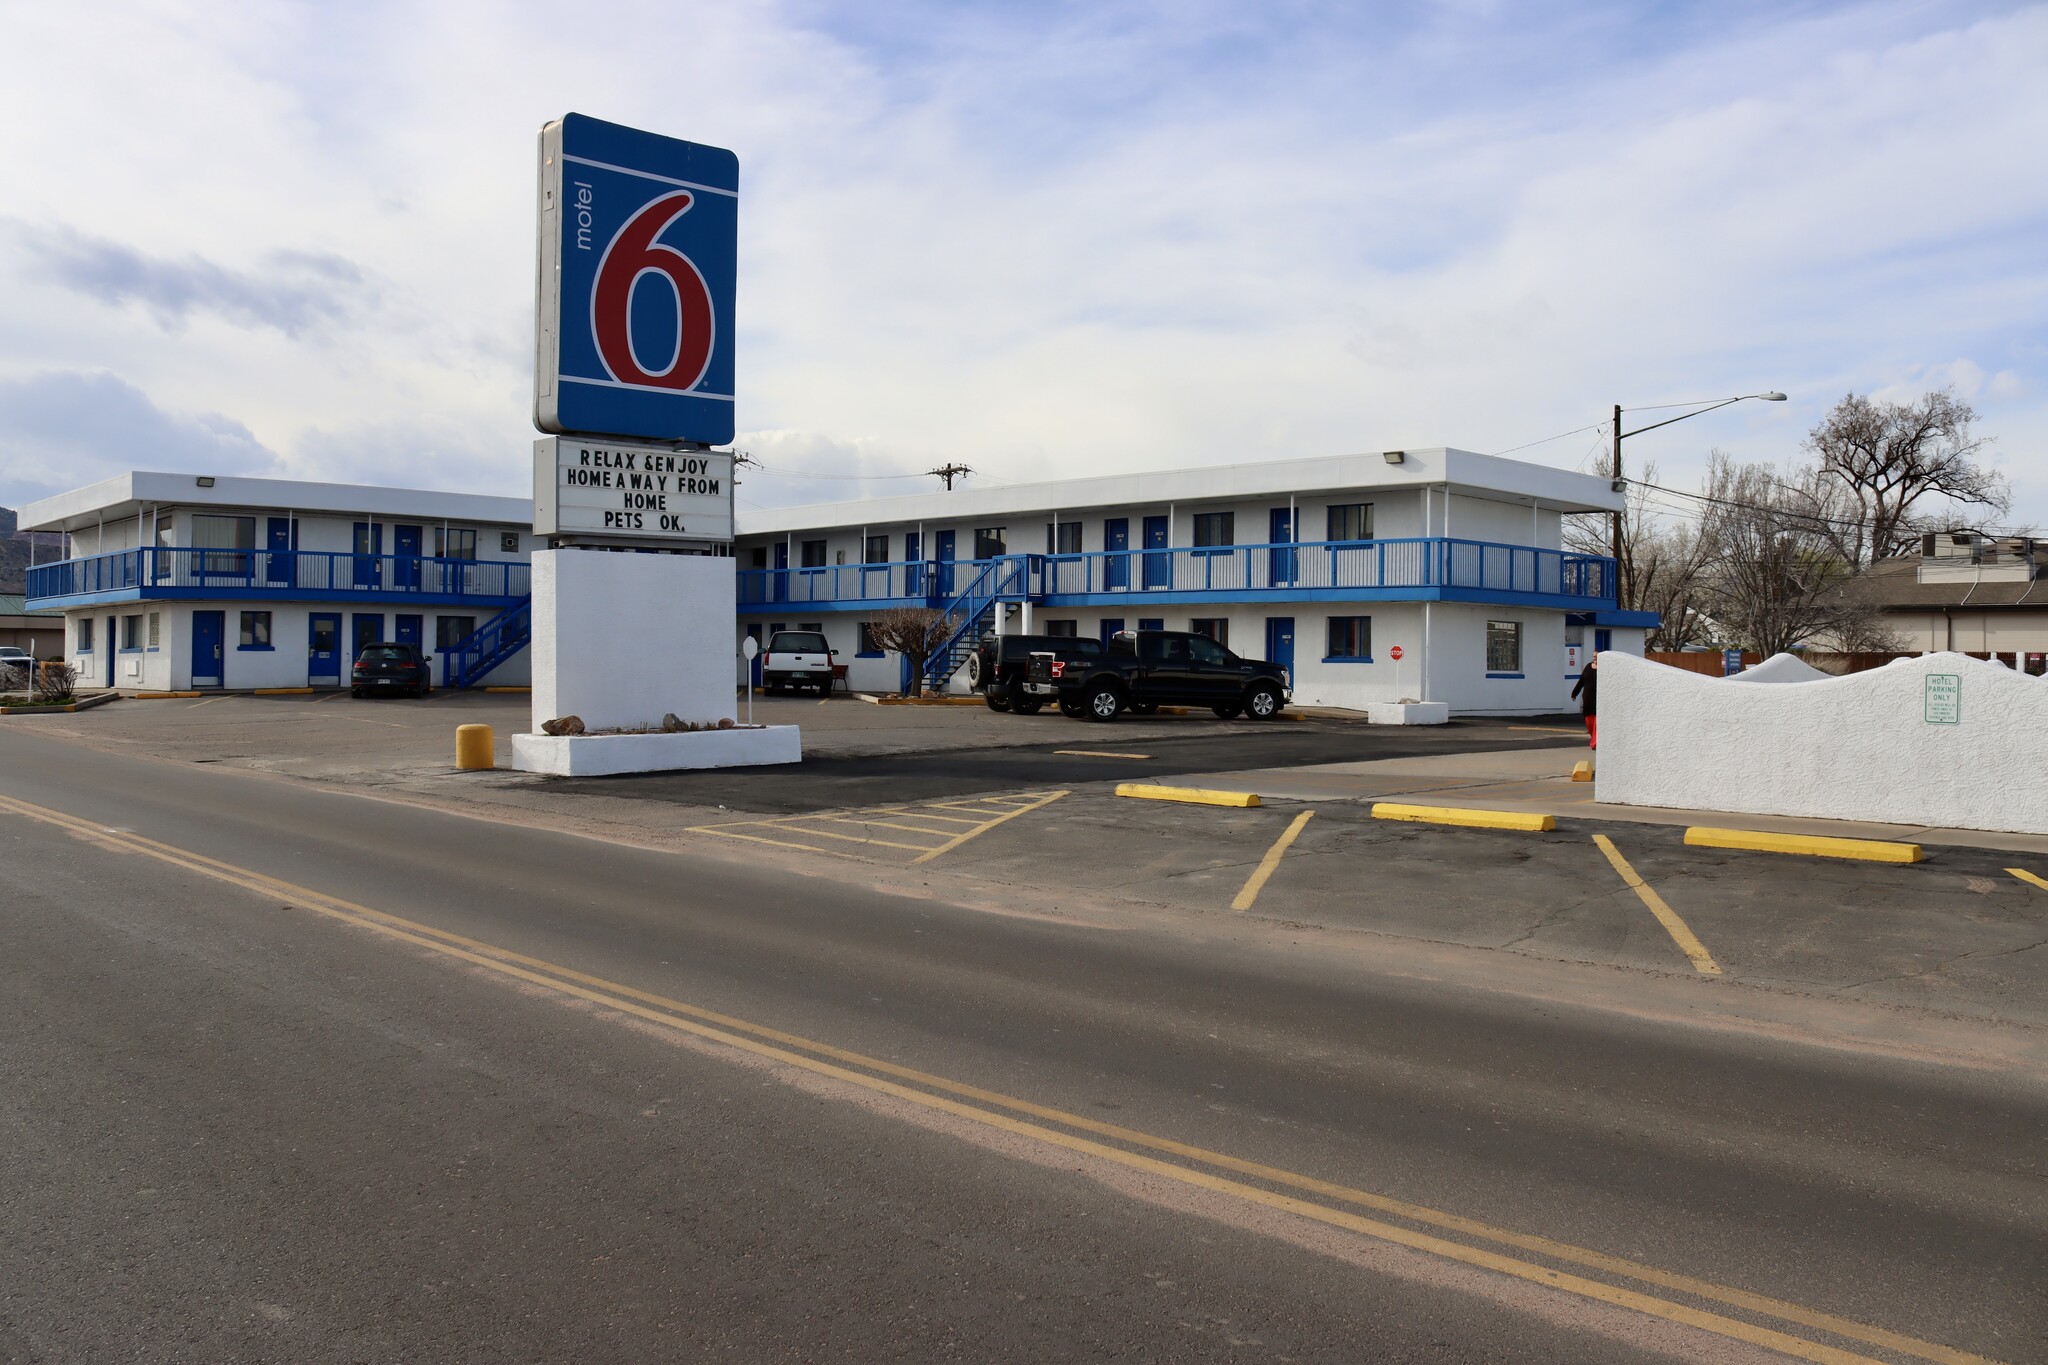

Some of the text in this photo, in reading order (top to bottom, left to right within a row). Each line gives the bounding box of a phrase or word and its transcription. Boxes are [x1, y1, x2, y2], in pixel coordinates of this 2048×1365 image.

[574, 181, 593, 251] motel
[590, 189, 716, 392] 6
[580, 449, 636, 470] RELAX
[678, 477, 720, 495] FROM
[624, 492, 667, 511] HOME
[604, 511, 686, 532] PETS OK.
